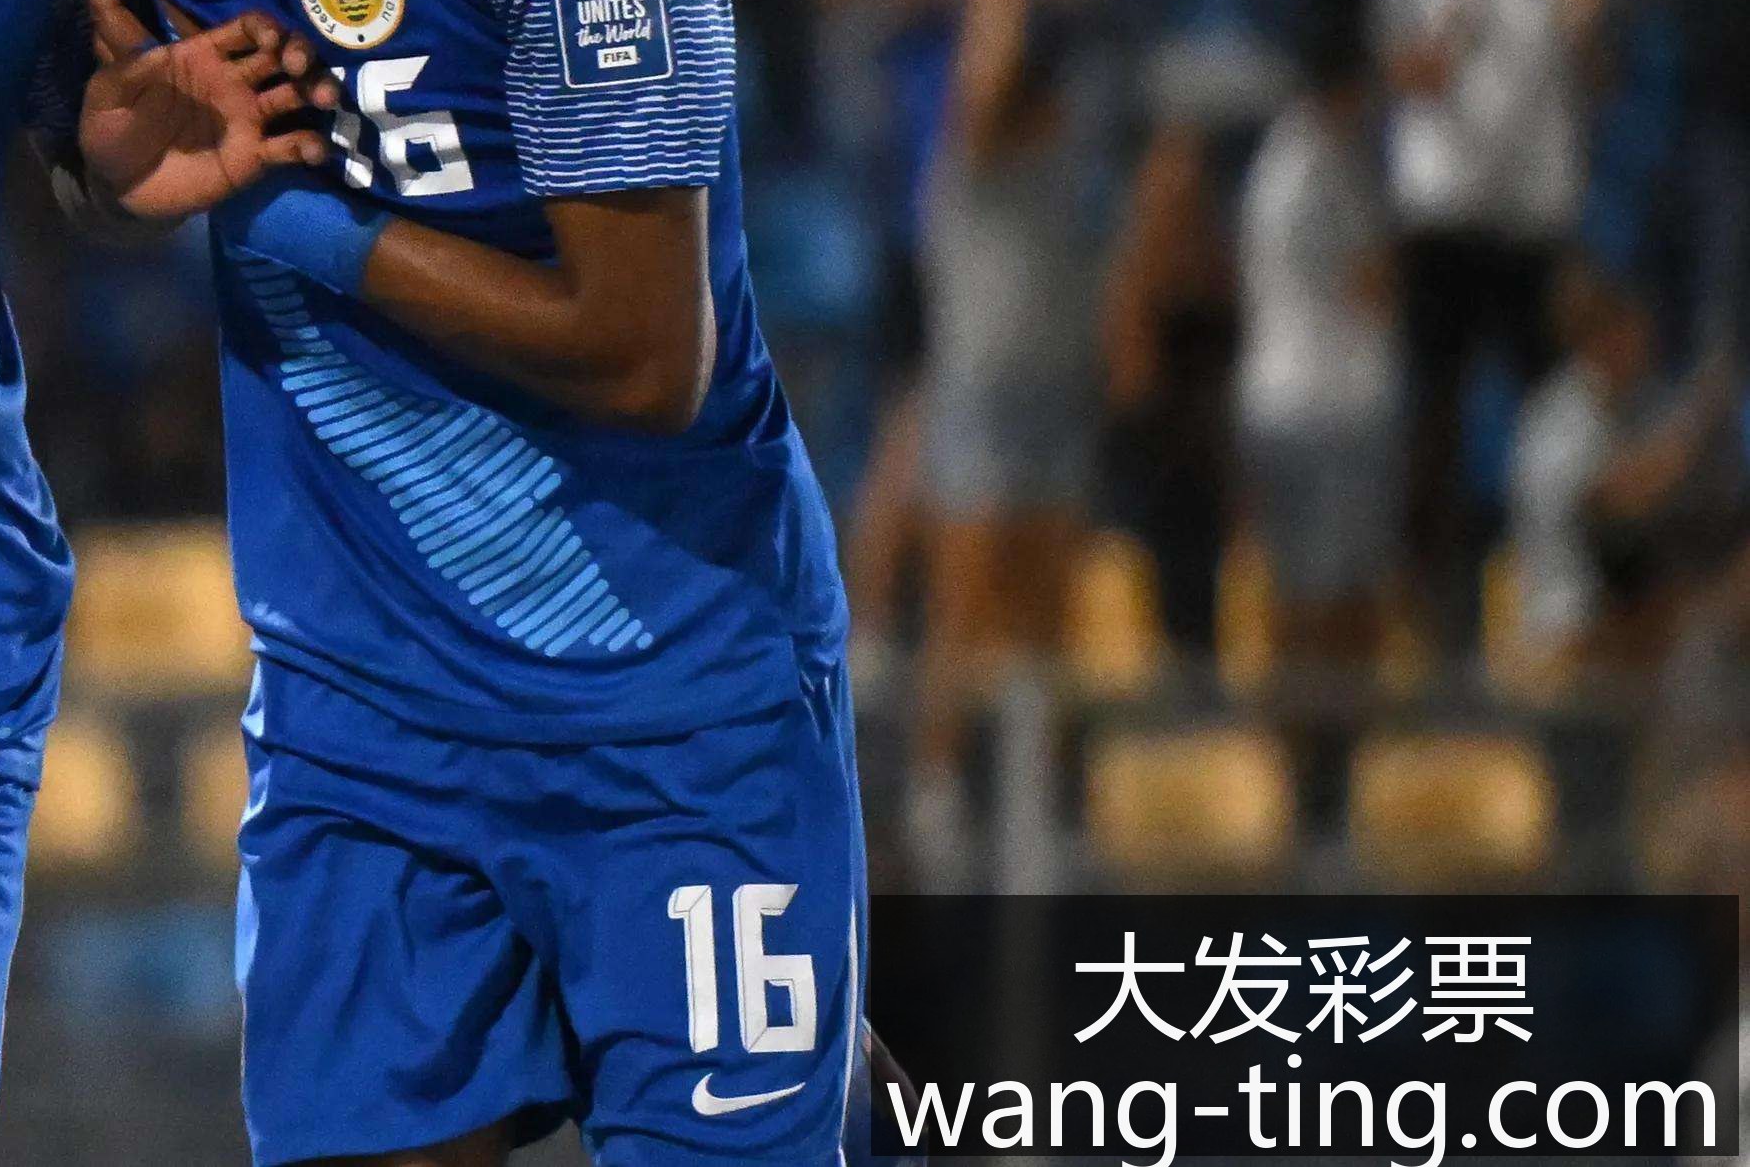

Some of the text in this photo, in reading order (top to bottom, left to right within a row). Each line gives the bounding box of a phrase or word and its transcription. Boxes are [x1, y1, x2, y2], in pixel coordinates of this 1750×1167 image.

[575, 18, 652, 47] the World
[603, 50, 632, 63] FIFA
[667, 884, 817, 1054] 16
